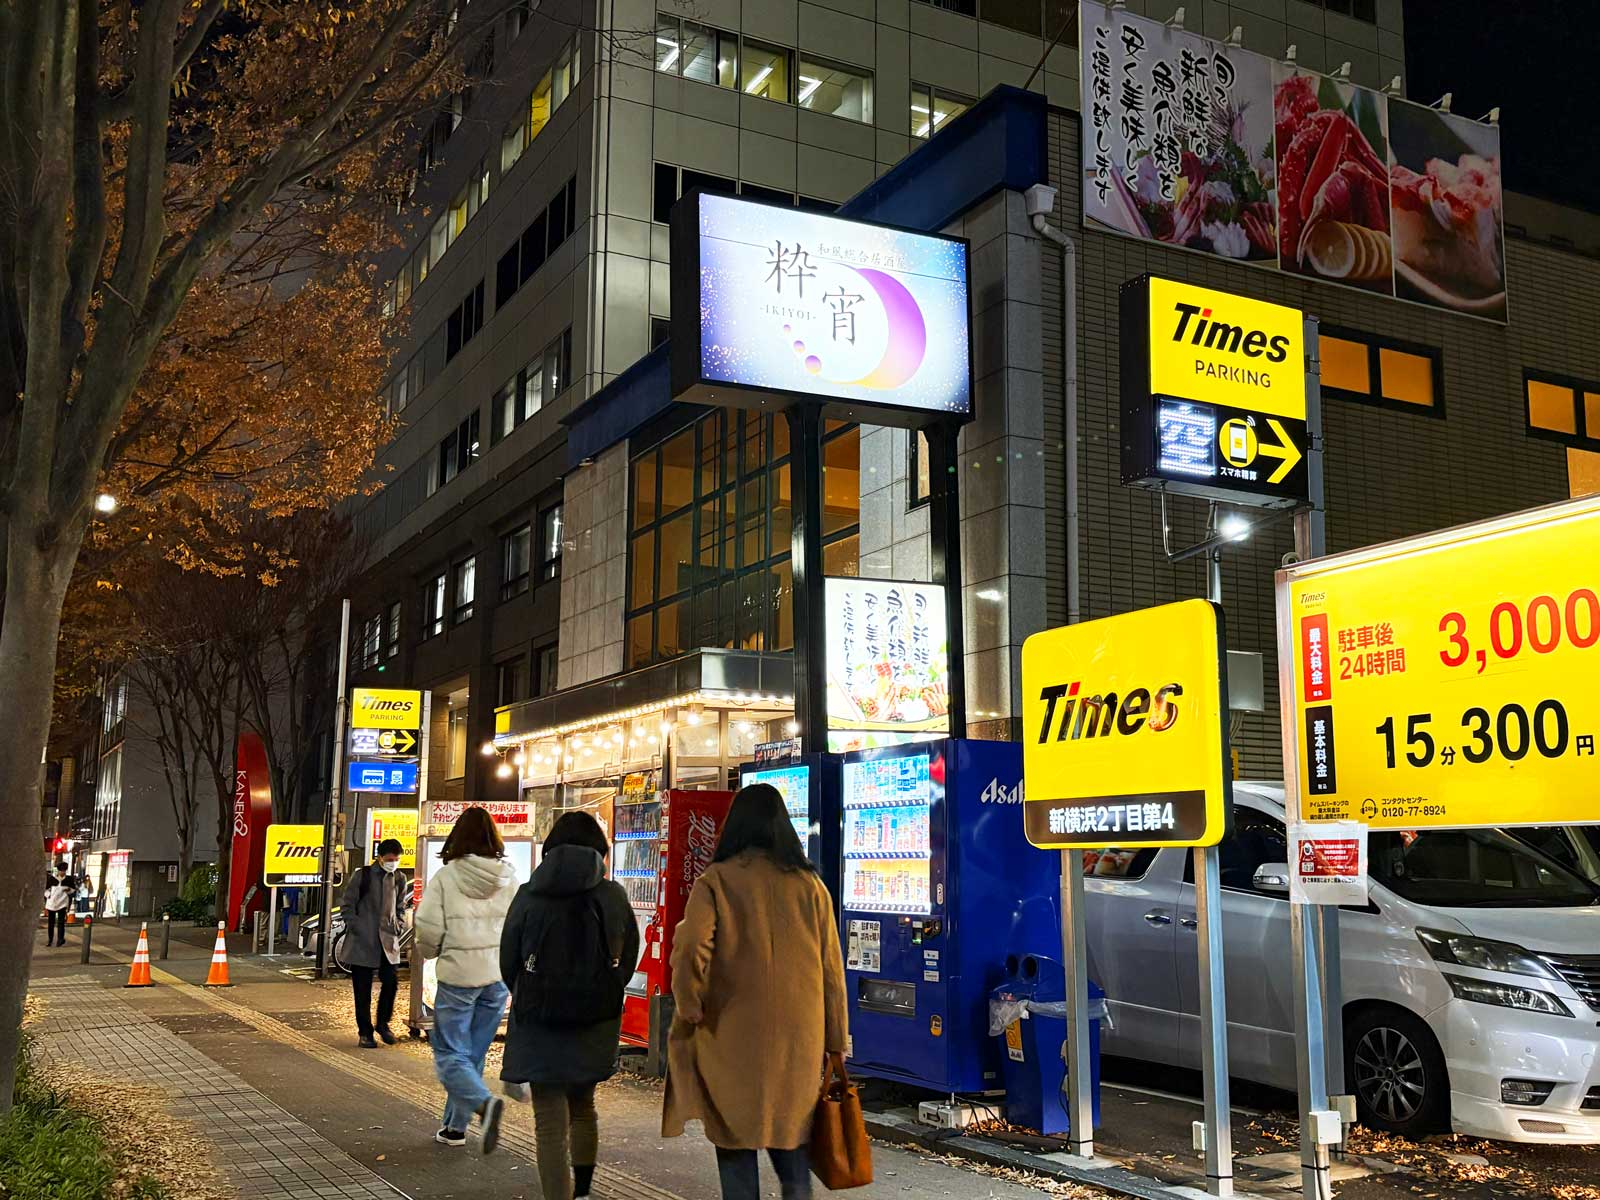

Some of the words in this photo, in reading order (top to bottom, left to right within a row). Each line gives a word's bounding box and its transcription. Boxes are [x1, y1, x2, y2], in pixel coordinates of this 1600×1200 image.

[1212, 52, 1236, 106] 旬の
[1172, 302, 1290, 363] Times
[1195, 359, 1271, 388] PARKING
[1300, 592, 1325, 604] Times
[1338, 622, 1394, 653] 駐車後
[1438, 588, 1600, 675] 3,000
[1309, 627, 1324, 686] 最大料金
[1339, 647, 1406, 681] 24時間
[361, 696, 414, 712] Times
[1038, 681, 1183, 744] Times
[1313, 719, 1328, 778] 基本料金
[1381, 797, 1428, 805] コンタクトセンター
[1381, 805, 1446, 818] 0120-77-8924
[1049, 802, 1175, 834] 新横浜2丁目第4
[275, 841, 325, 858] Time
